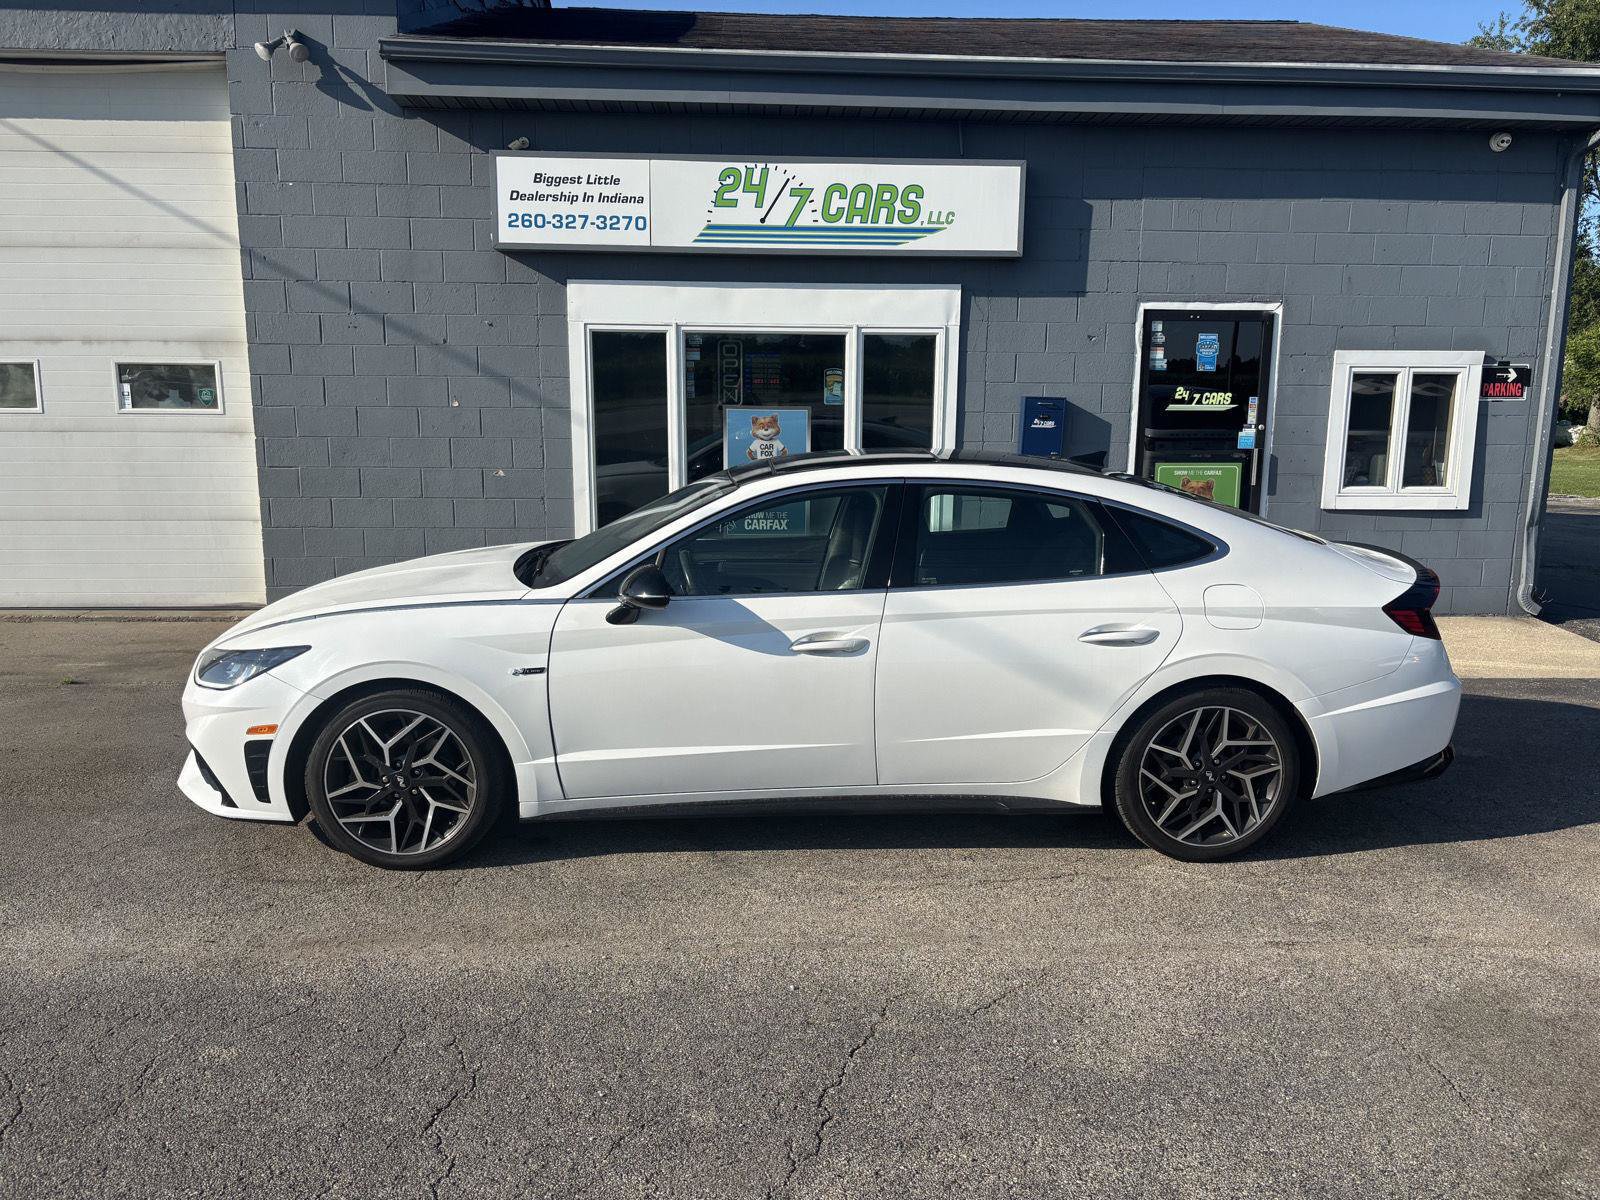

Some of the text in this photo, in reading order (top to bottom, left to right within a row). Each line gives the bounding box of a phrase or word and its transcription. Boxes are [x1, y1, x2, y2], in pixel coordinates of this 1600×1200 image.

[533, 172, 621, 187] Biggest Little
[509, 190, 645, 205] Dealership In Indiana
[507, 212, 648, 231] 260-327-3270
[927, 211, 956, 225] LLC
[723, 344, 738, 403] OPEN
[1482, 382, 1522, 397] PARKING
[1202, 392, 1233, 405] CARS
[776, 511, 788, 519] THE
[744, 519, 788, 530] CARFAX
